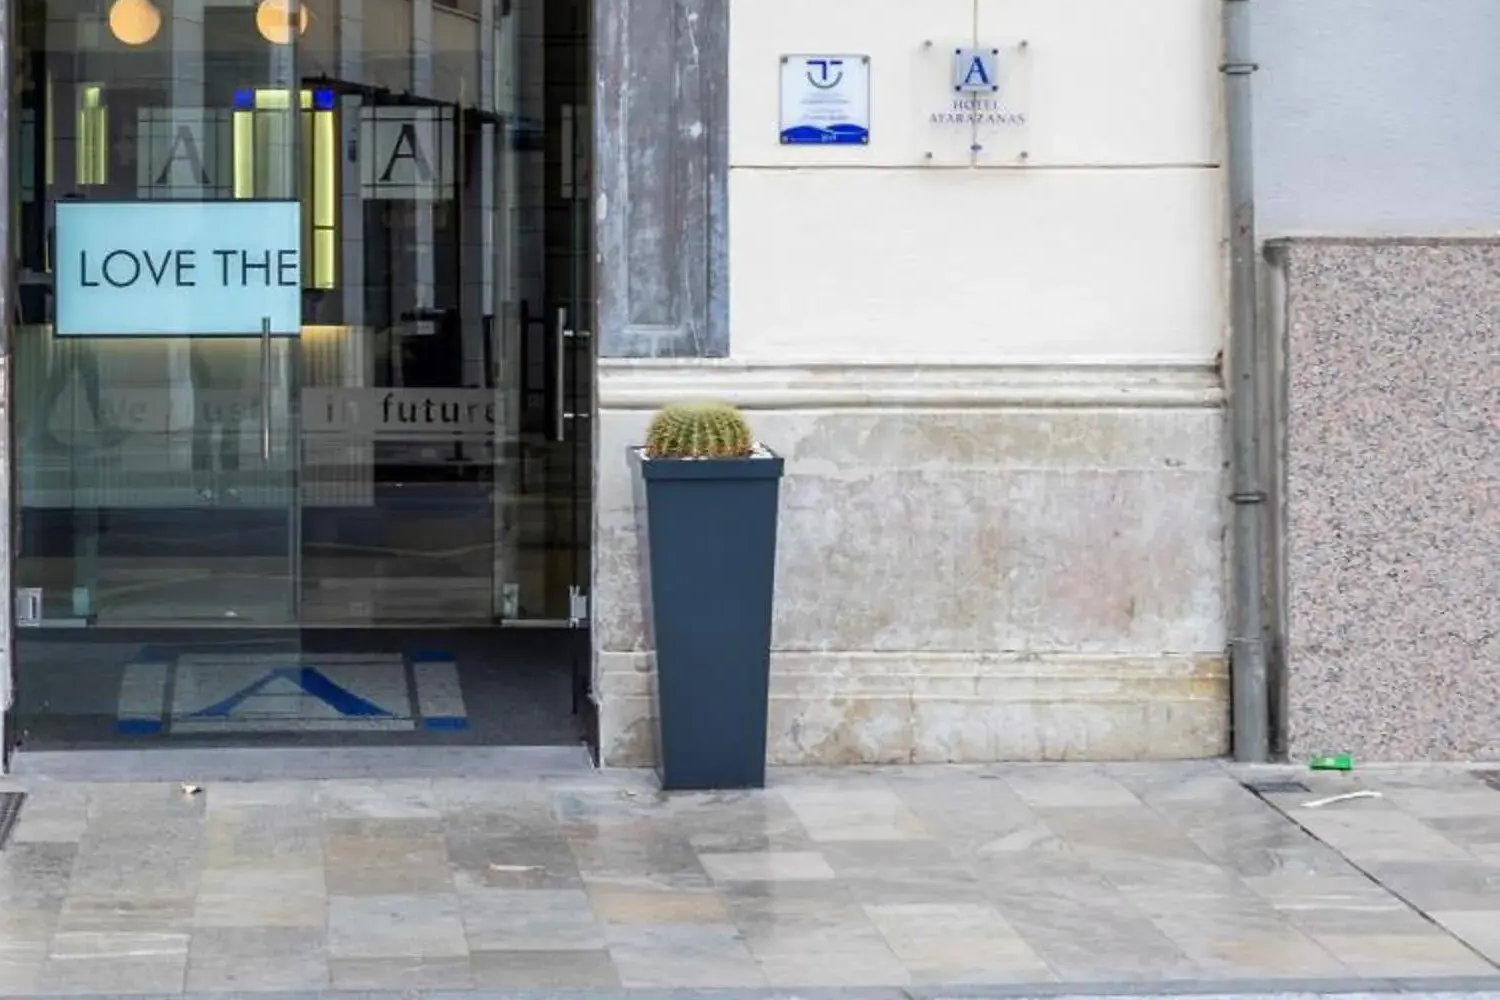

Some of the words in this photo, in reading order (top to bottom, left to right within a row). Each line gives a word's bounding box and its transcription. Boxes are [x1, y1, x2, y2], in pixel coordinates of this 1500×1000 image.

[965, 56, 988, 84] A
[929, 113, 1025, 123] ATARAZANAS
[953, 100, 999, 110] HOTEL
[156, 125, 210, 184] A
[380, 124, 432, 181] A
[80, 250, 195, 287] LOVE
[214, 250, 297, 287] THE
